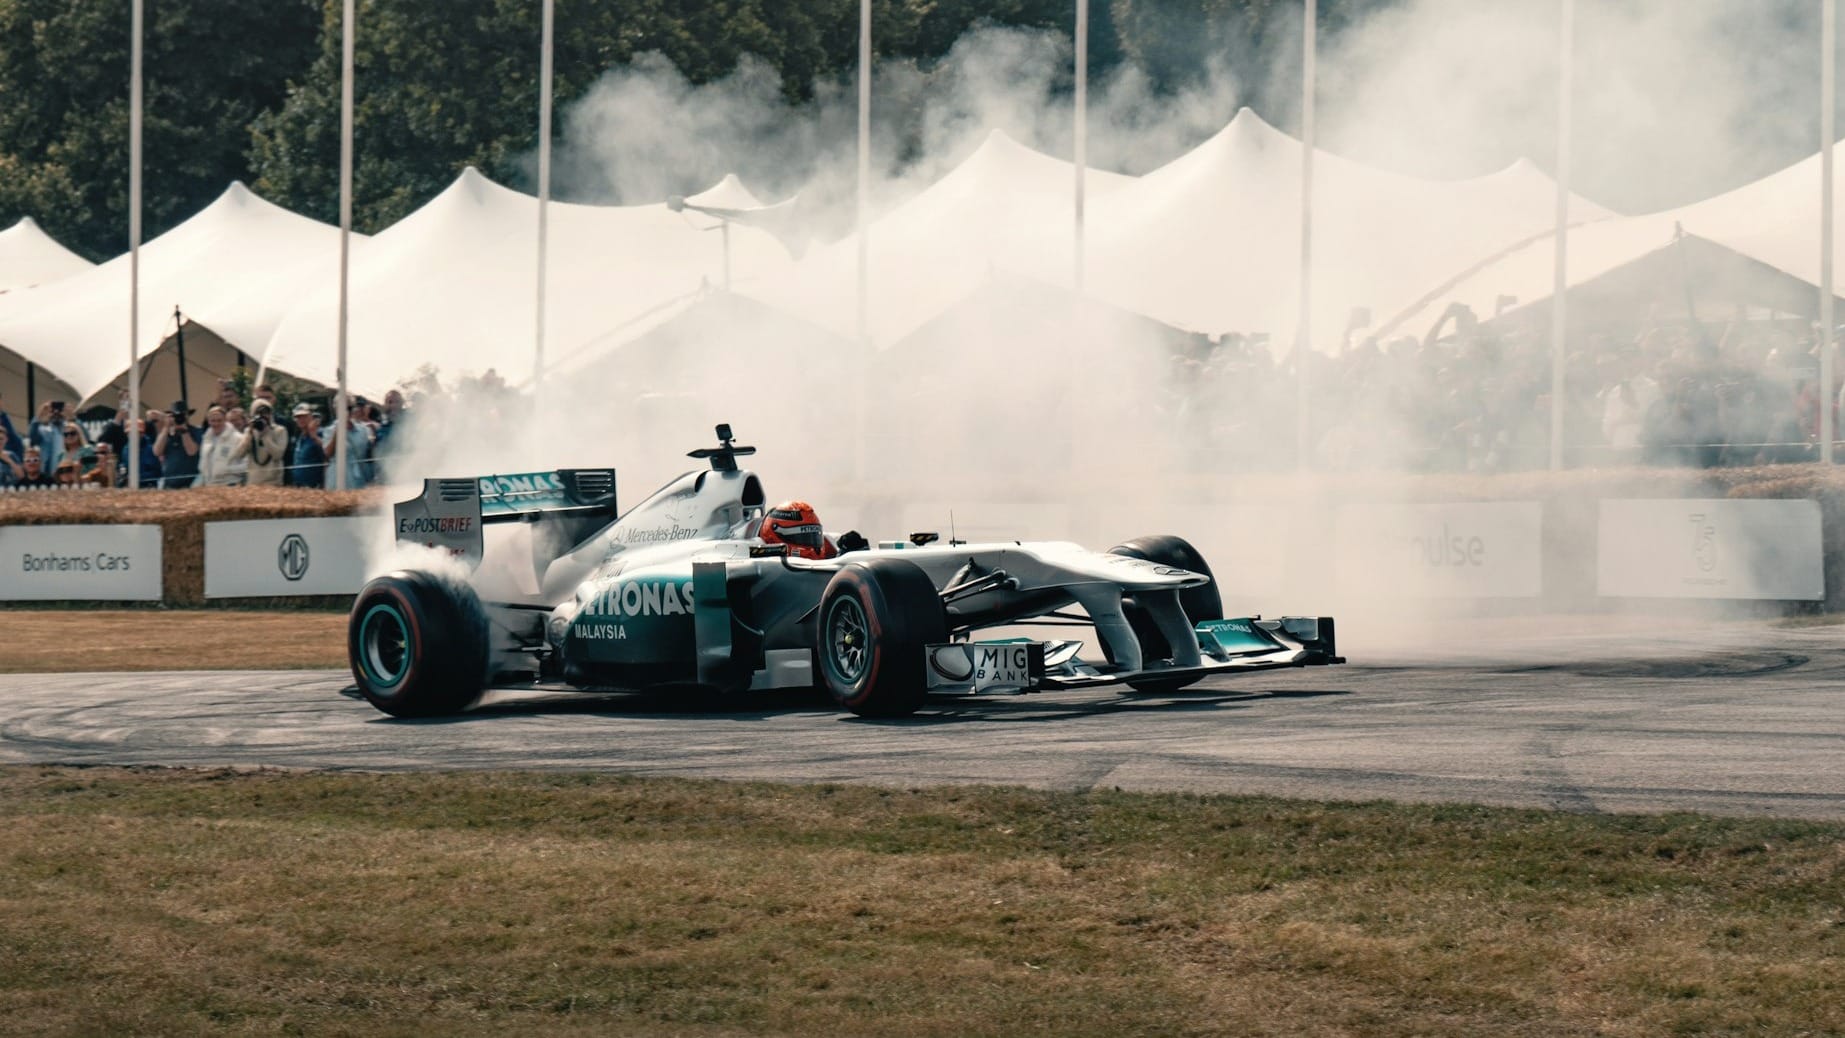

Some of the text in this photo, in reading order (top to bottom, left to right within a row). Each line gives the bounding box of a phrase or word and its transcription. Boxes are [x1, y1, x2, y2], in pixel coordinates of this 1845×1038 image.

[625, 524, 698, 544] Mercedes-Benz
[22, 552, 130, 572] Bonhams Cars
[280, 537, 308, 578] MG
[574, 623, 627, 640] MALAYSIA
[980, 647, 1027, 669] MIG
[976, 669, 1028, 681] BANK
